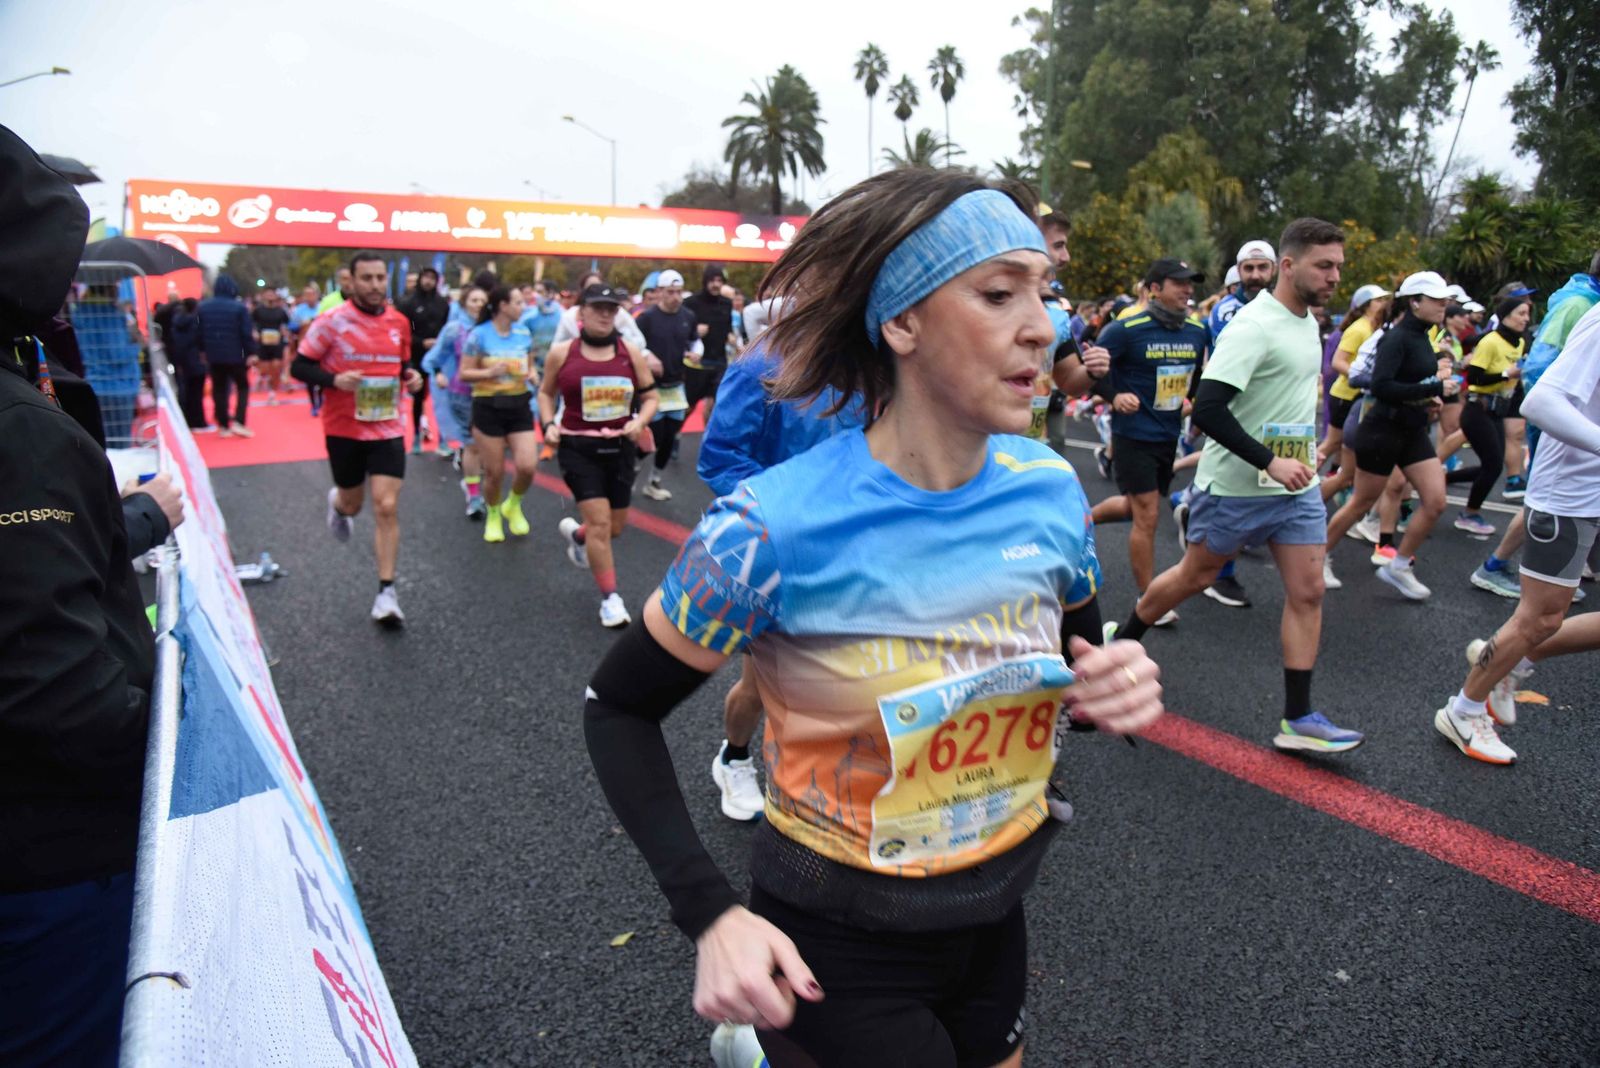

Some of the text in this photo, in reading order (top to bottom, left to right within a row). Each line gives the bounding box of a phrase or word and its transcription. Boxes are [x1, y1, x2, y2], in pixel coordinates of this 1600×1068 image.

[30, 508, 75, 522] SPORT
[907, 592, 1040, 664] MEDIO
[956, 766, 995, 786] LAURA
